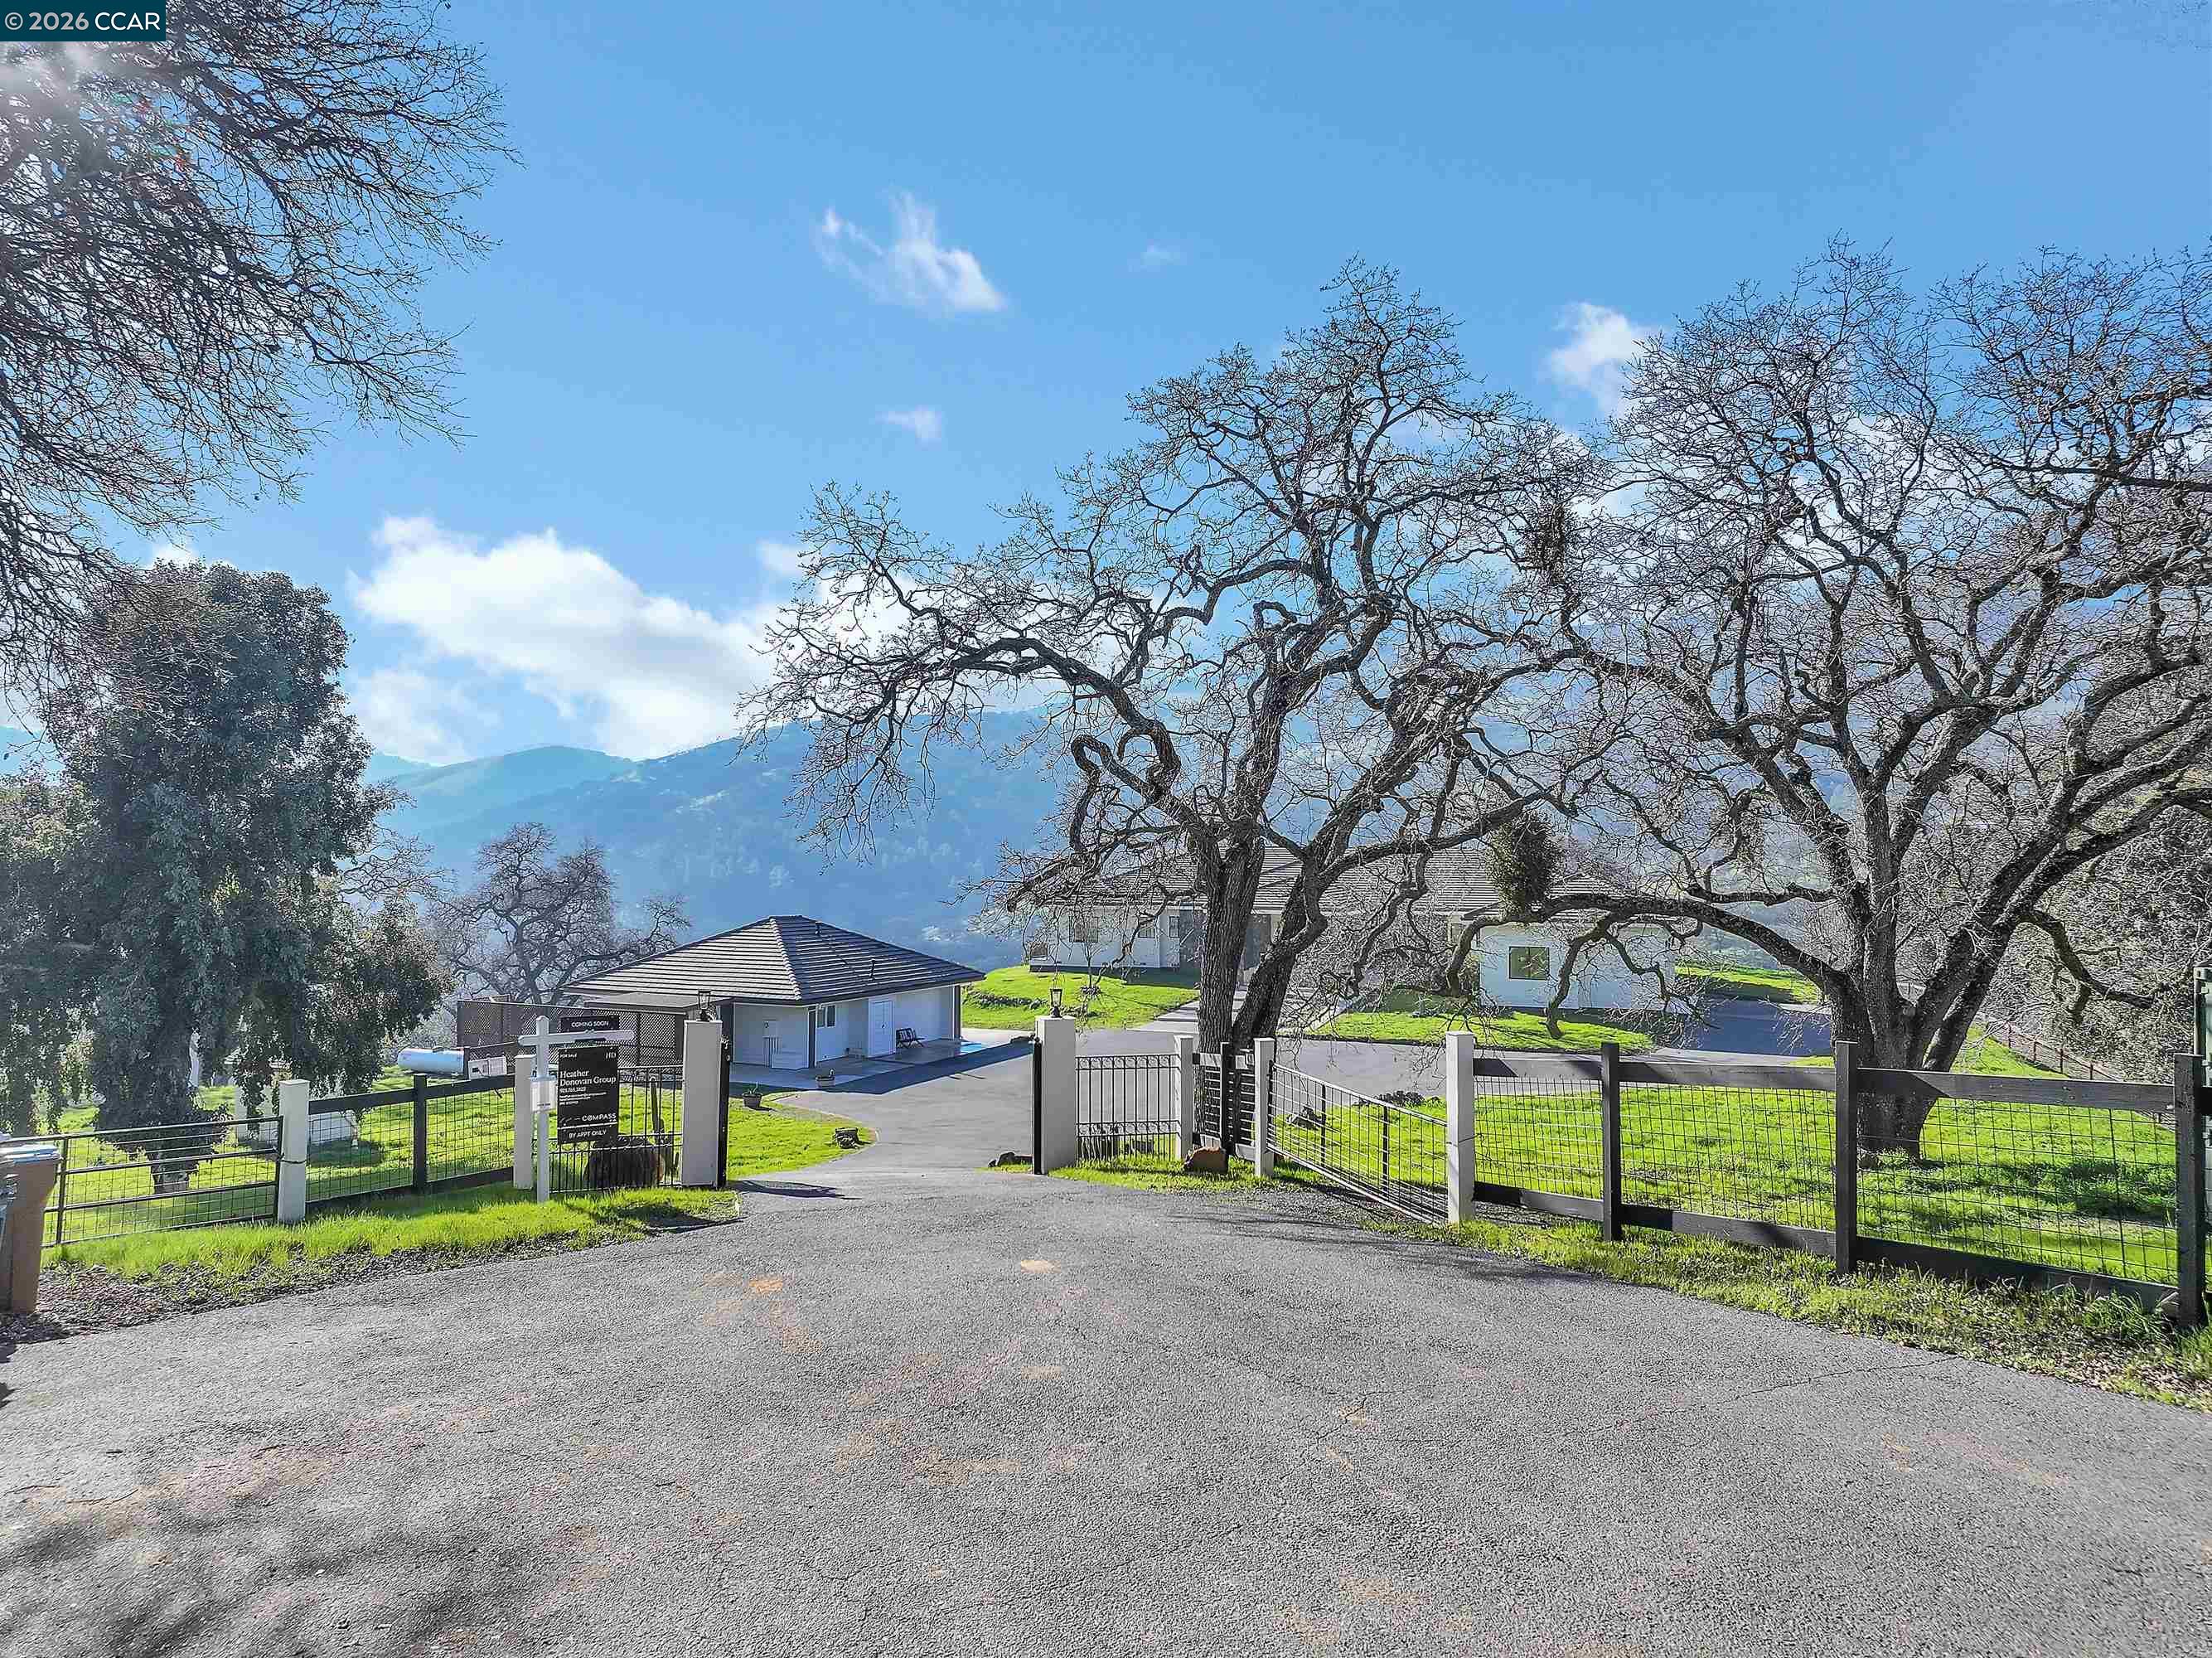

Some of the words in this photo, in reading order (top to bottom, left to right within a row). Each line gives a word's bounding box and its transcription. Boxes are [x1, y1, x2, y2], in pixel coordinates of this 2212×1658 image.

[559, 1069, 589, 1079] Heather
[559, 1078, 592, 1087] Donovan
[593, 1076, 617, 1084] Group
[582, 1113, 617, 1122] COMPASS
